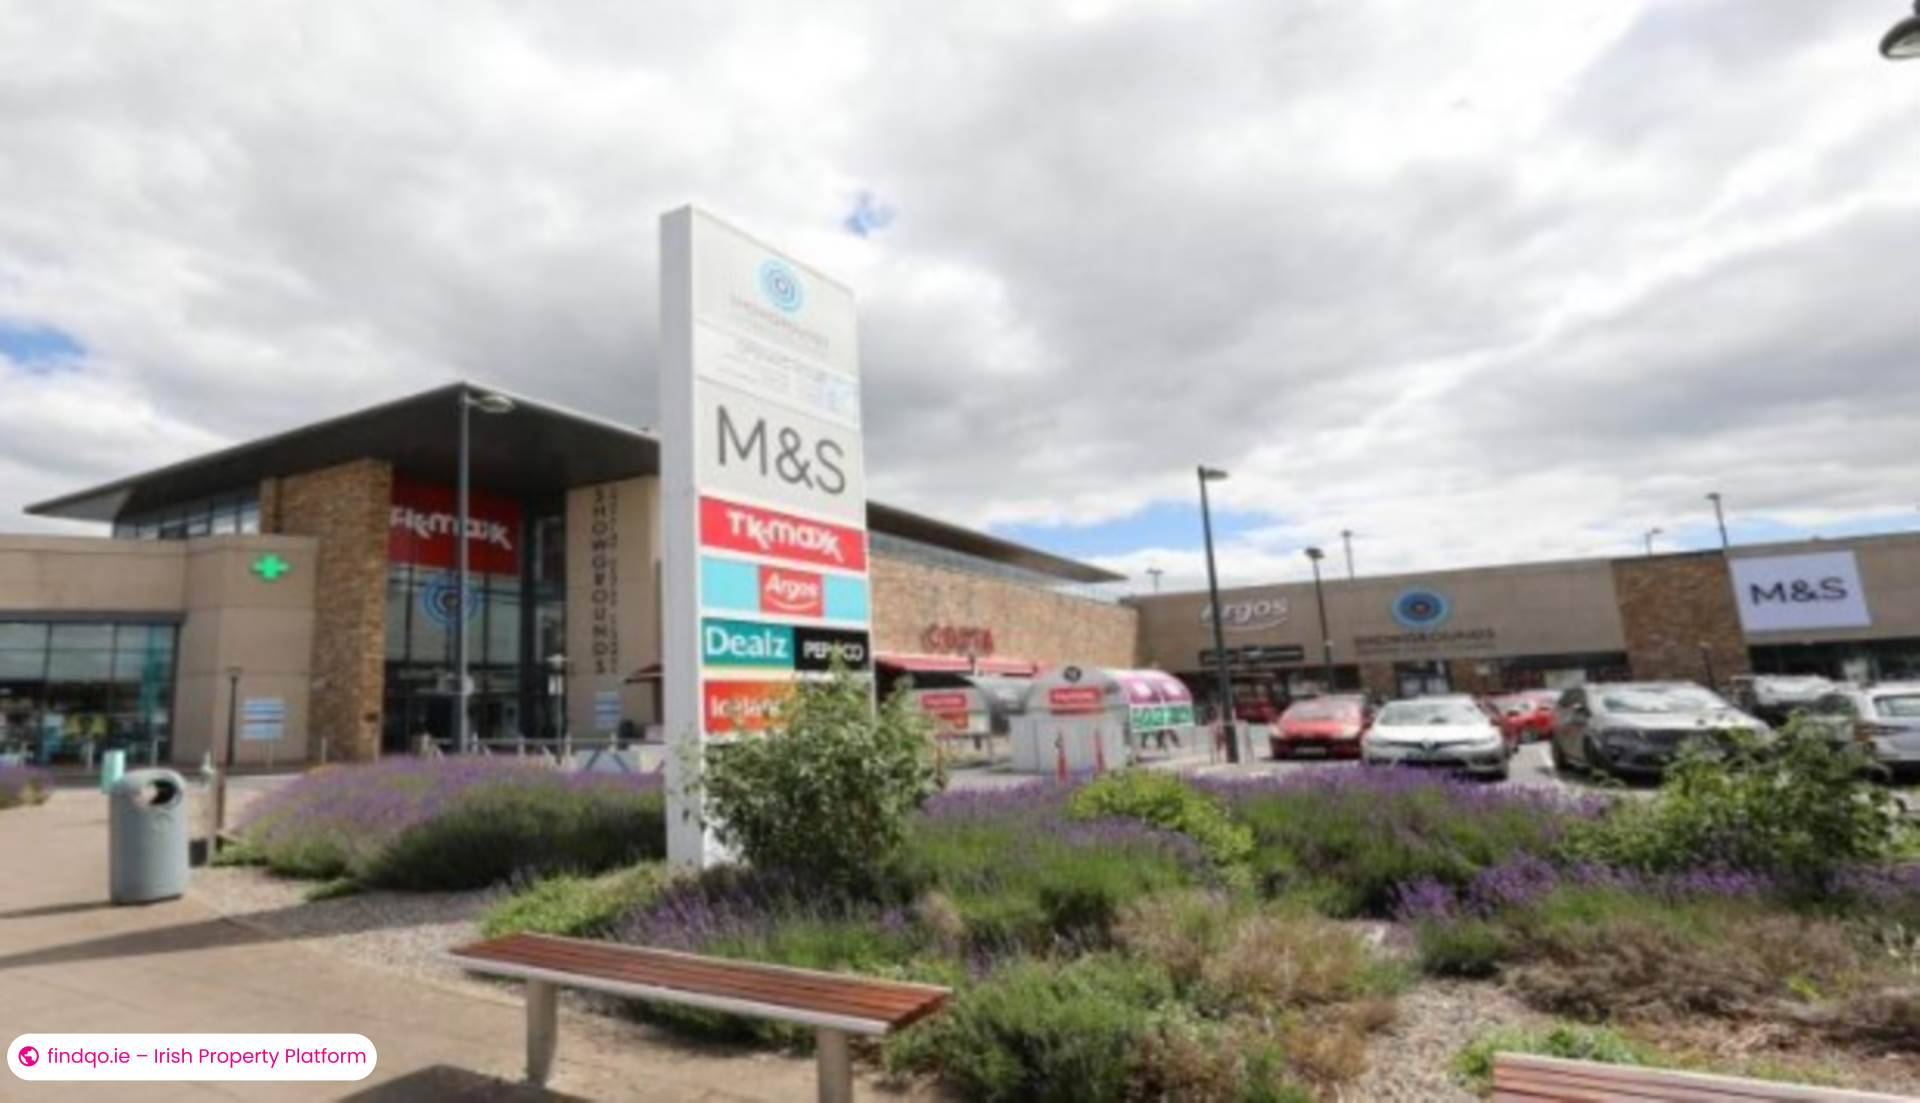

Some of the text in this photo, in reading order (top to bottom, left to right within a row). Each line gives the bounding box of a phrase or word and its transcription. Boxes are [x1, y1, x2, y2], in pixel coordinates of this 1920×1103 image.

[717, 404, 846, 495] M&S
[765, 572, 819, 601] Argos
[1749, 576, 1849, 606] M&S
[705, 625, 790, 659] Dealz
[802, 640, 865, 662] PEPCO
